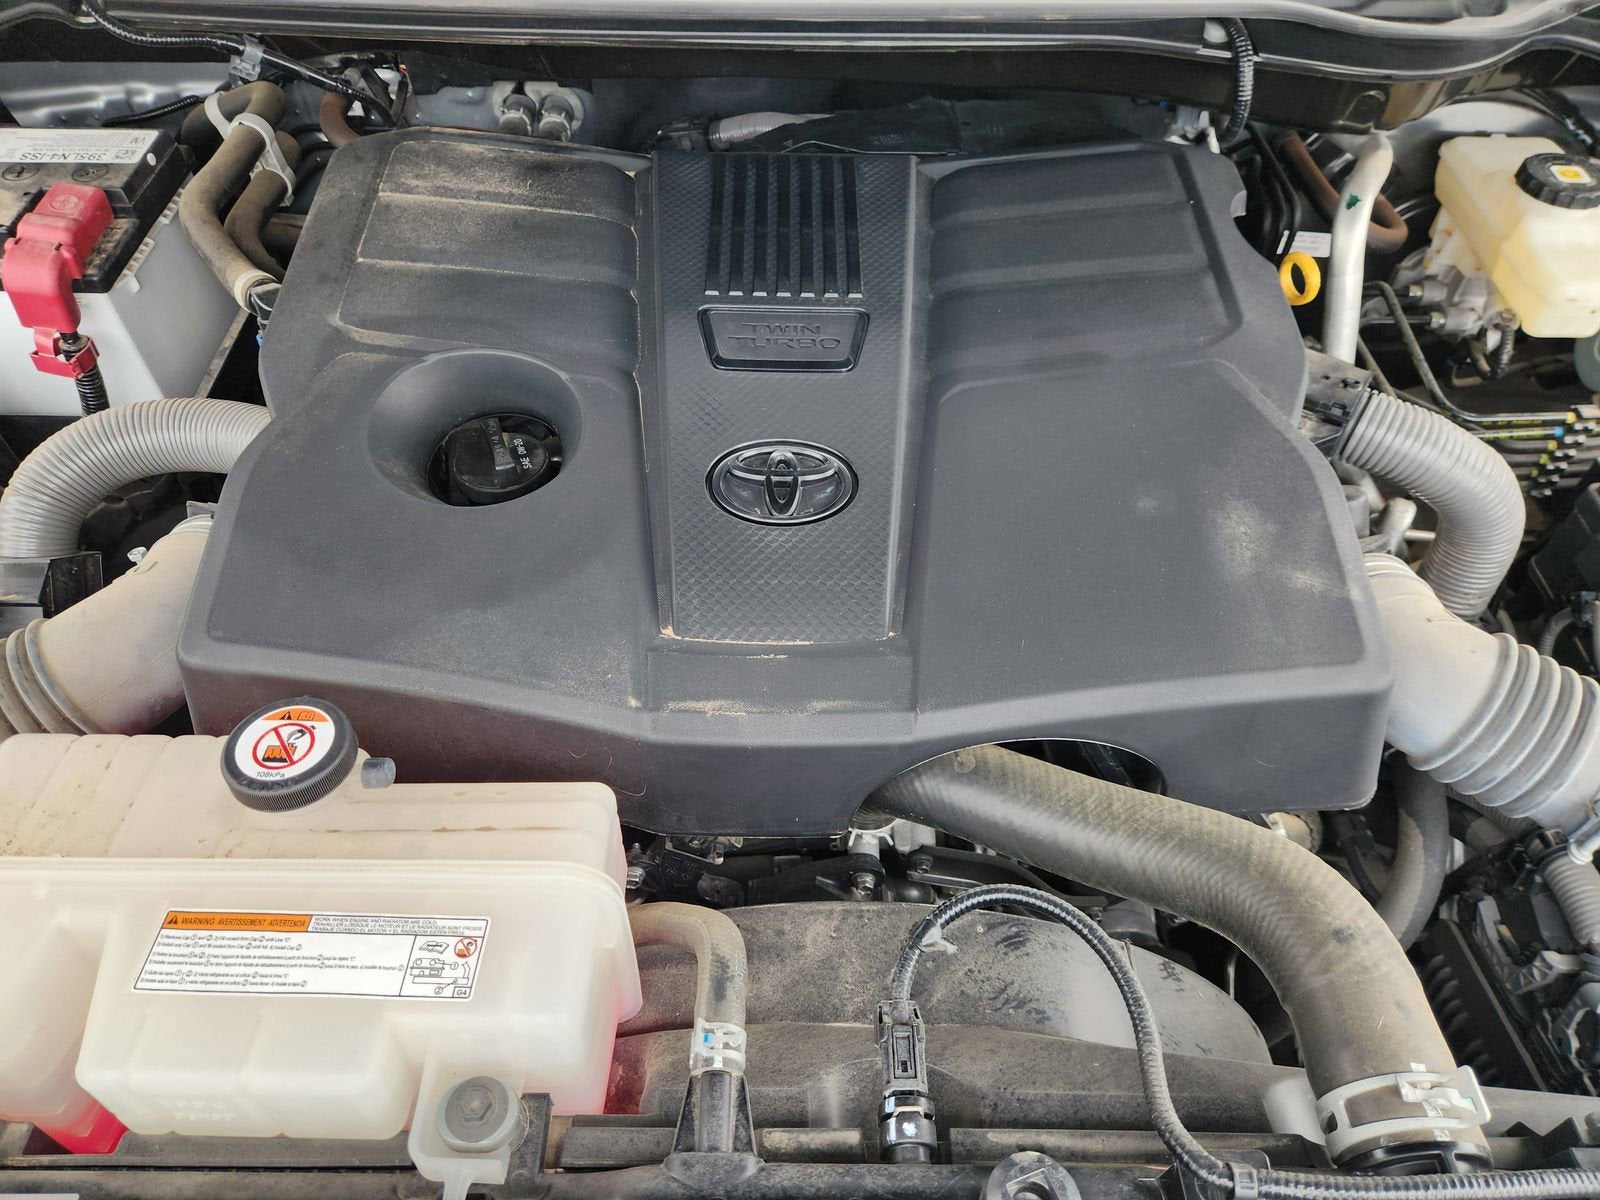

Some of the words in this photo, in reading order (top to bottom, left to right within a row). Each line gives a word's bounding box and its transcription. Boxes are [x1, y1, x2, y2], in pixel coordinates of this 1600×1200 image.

[742, 323, 821, 336] TWIN
[728, 336, 841, 349] TURBO
[520, 457, 532, 469] SAE
[181, 916, 216, 926] WARNING
[217, 917, 267, 926] AVERTISSEMENT
[268, 919, 306, 928] ADVERTENCIA
